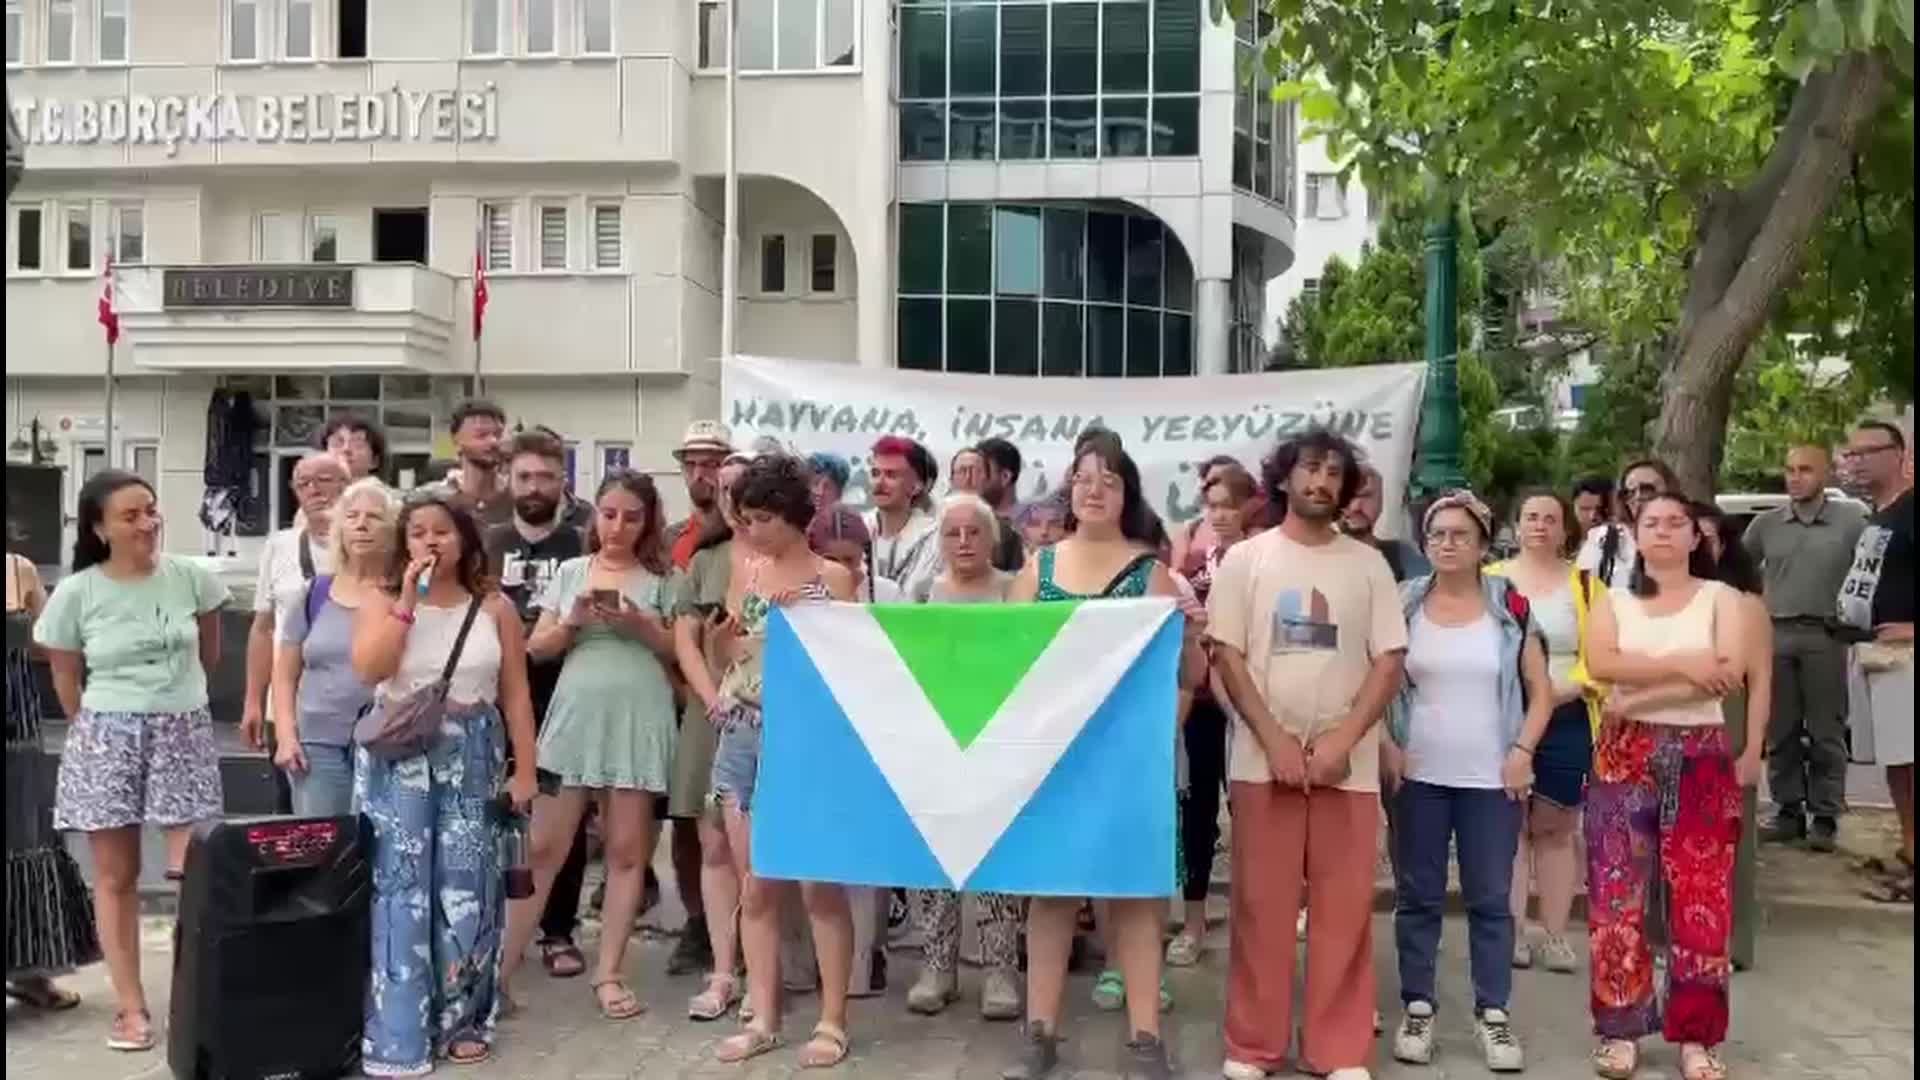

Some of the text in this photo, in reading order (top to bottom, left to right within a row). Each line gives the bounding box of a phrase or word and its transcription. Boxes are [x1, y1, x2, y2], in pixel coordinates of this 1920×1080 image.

[256, 80, 497, 142] BELEDİYESİ
[173, 273, 346, 298] BELEDİYE
[731, 398, 928, 440] HAYVANA,
[1141, 401, 1394, 442] YERYÜZÜNE
